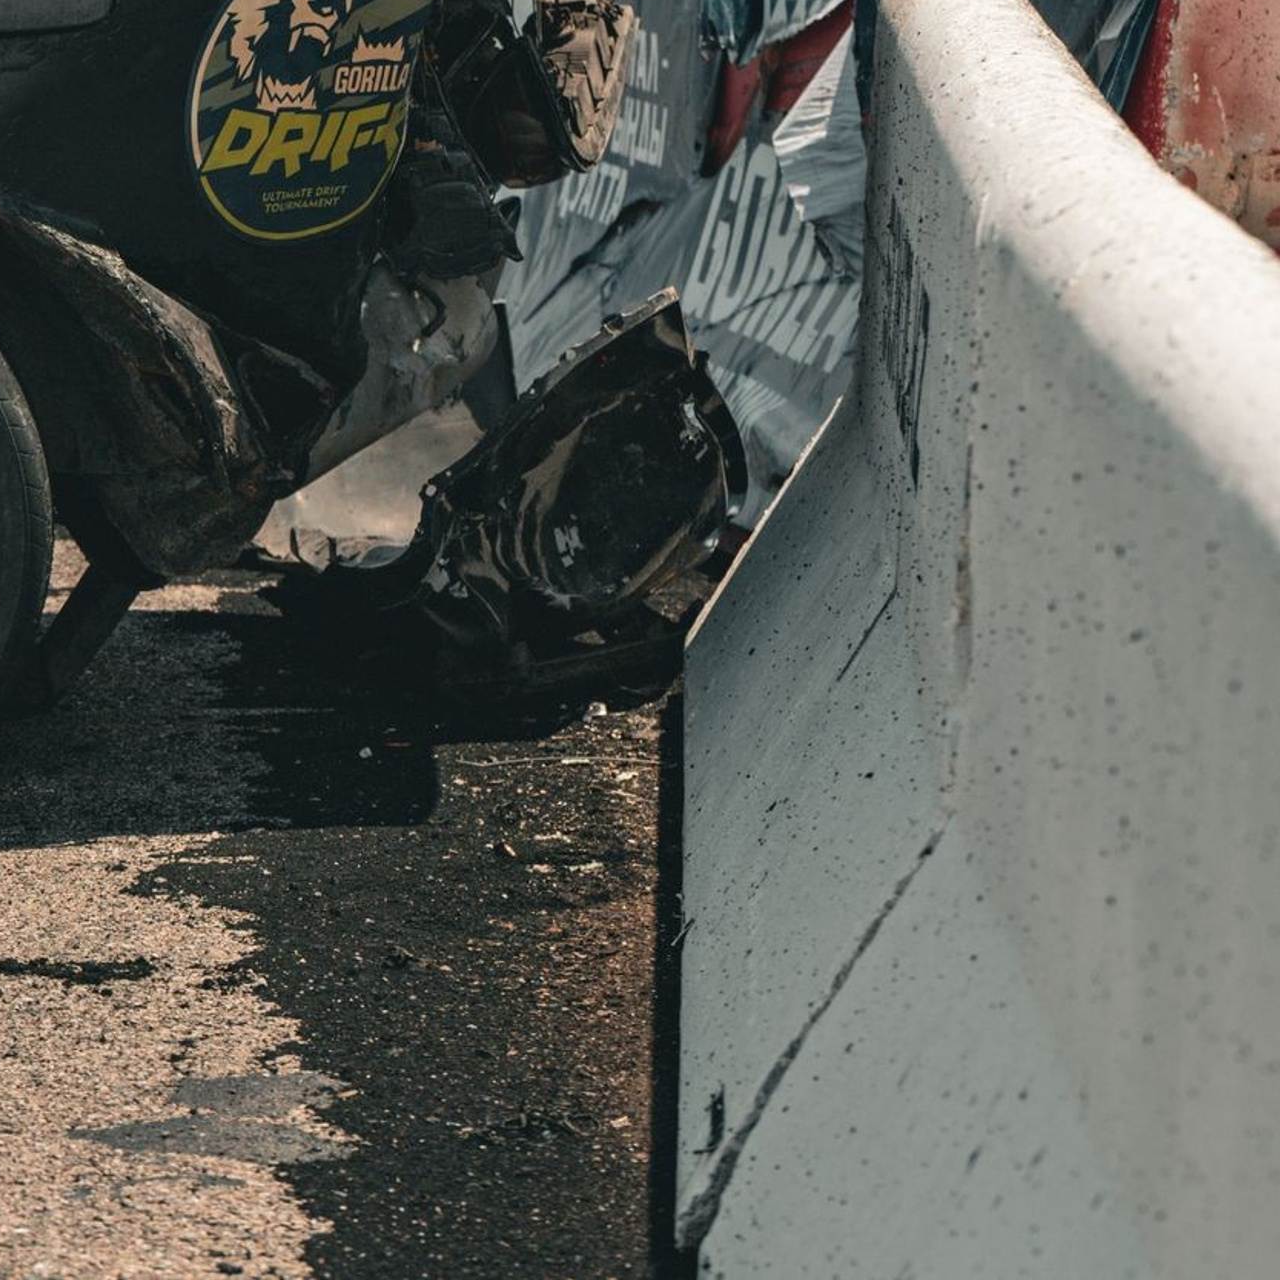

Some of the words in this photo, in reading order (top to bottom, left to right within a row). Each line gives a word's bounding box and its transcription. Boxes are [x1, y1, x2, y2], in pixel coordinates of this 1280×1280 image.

[262, 187, 315, 202] ULTIMATE
[315, 184, 348, 197] DRIFT
[264, 196, 340, 214] TOURNAMENT
